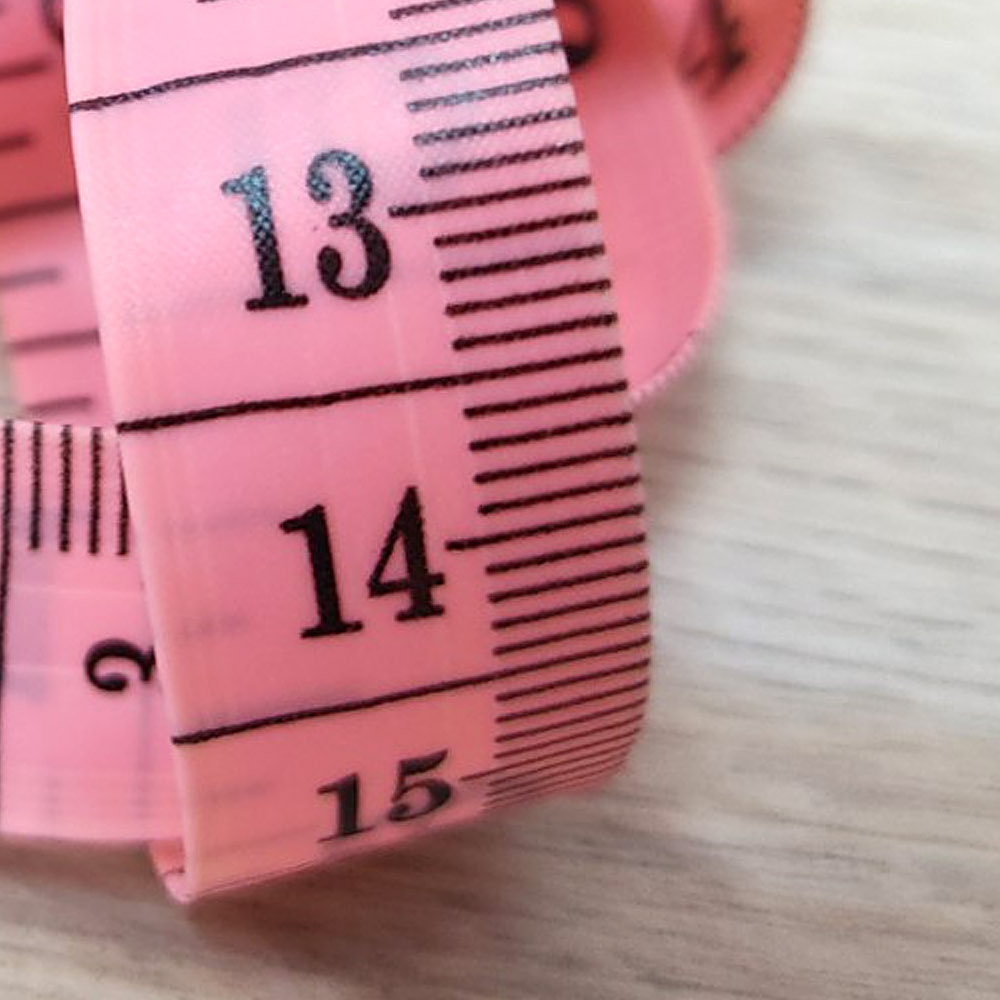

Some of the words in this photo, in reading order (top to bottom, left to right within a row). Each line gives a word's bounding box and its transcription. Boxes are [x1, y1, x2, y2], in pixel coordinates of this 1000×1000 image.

[220, 148, 392, 312] 13
[279, 485, 446, 639] 14
[317, 748, 453, 843] 15
